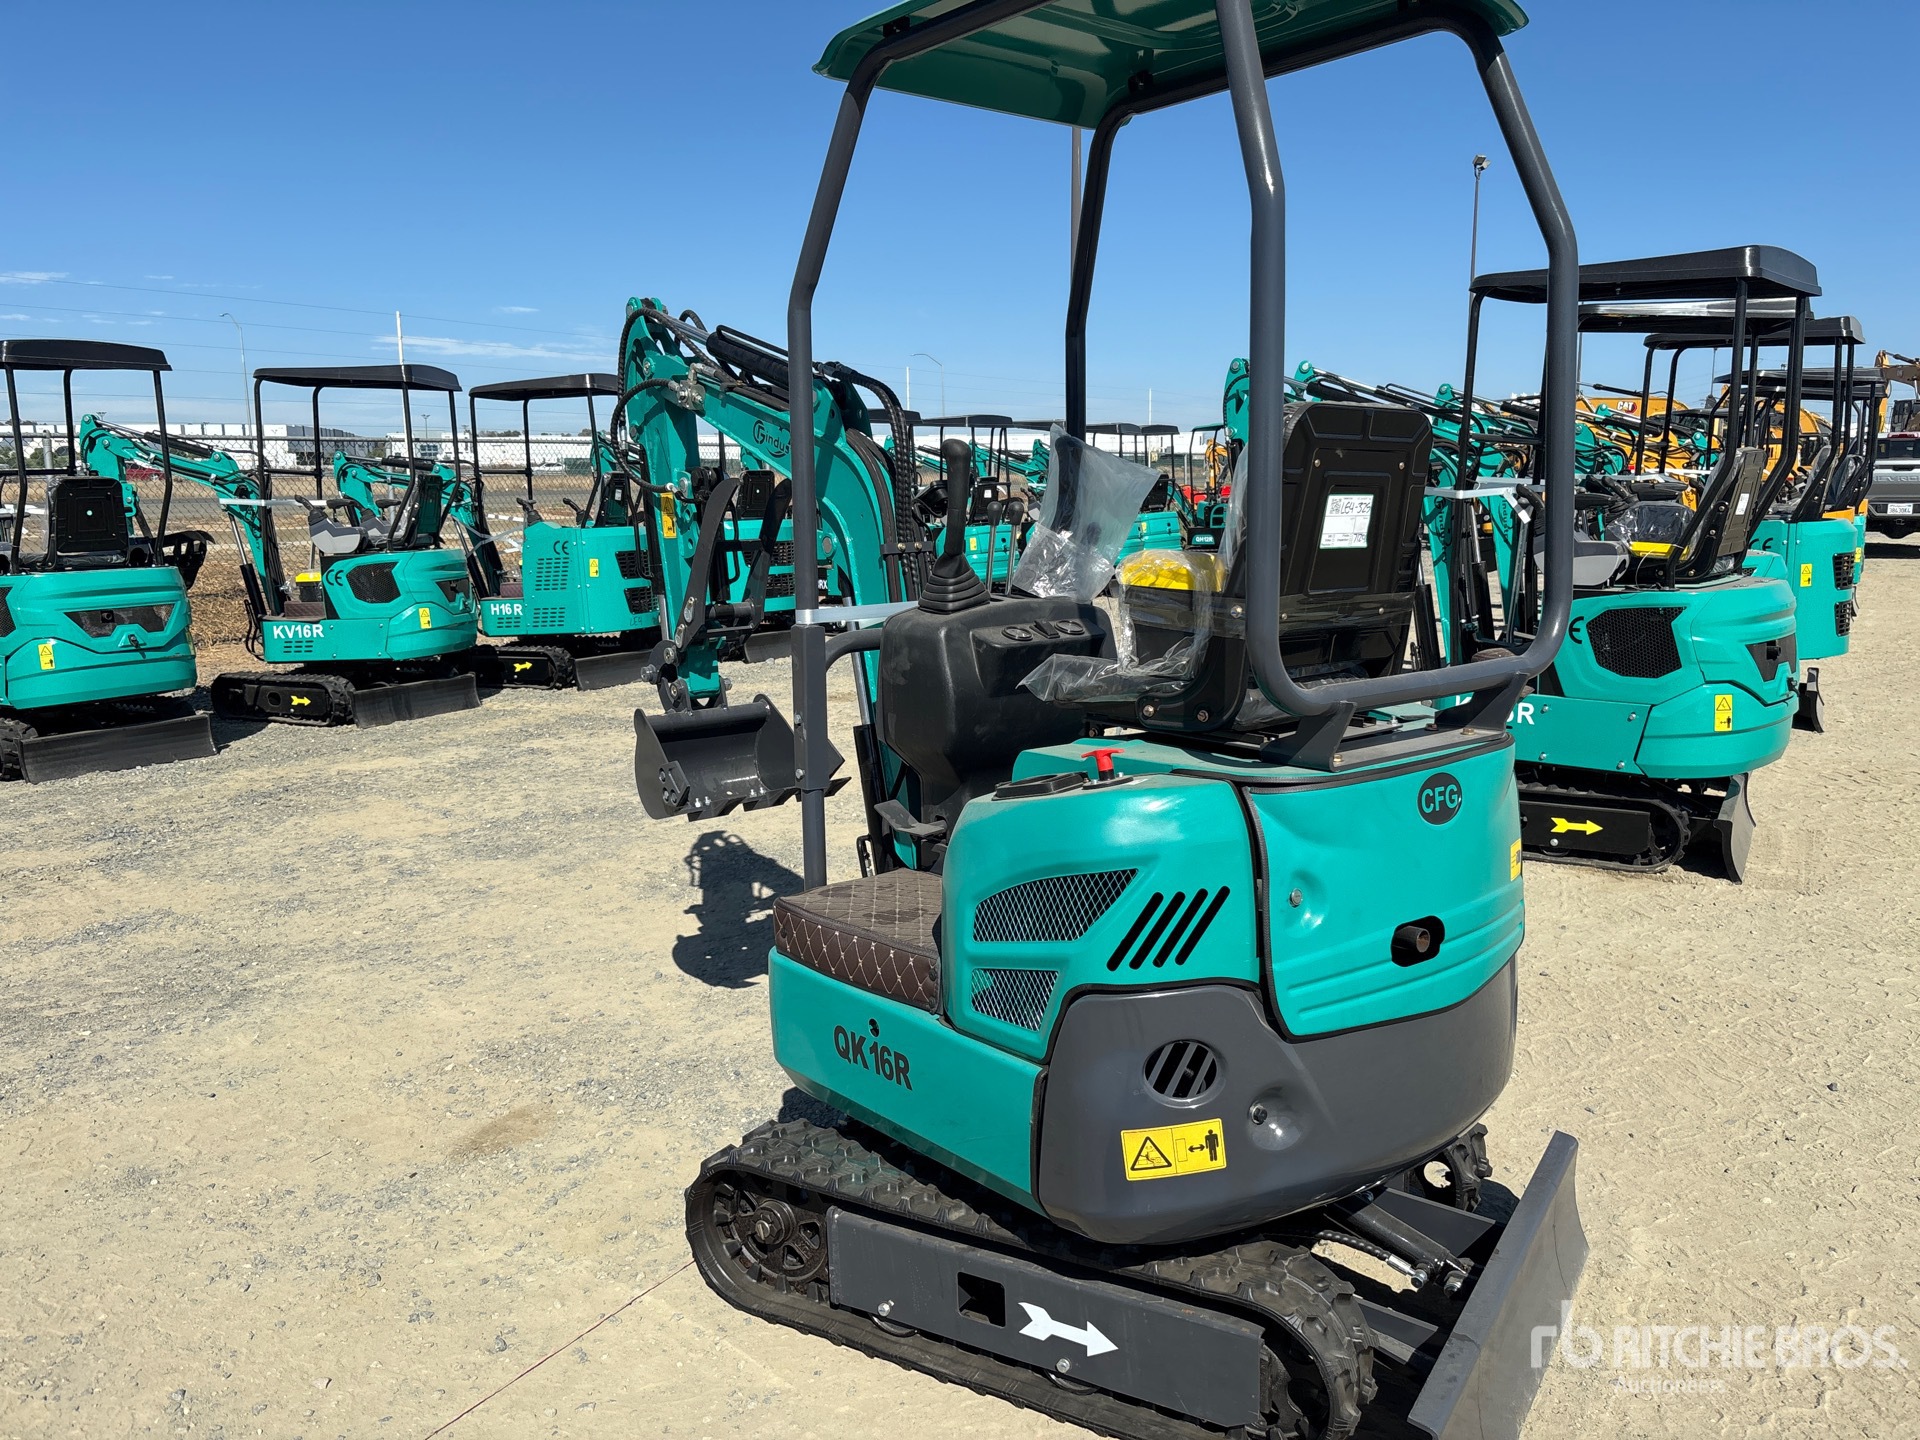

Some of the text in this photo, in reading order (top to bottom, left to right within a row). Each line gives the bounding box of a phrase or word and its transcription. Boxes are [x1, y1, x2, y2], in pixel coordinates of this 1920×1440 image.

[1617, 401, 1634, 412] CAT
[325, 569, 344, 587] CE
[273, 624, 325, 639] KV16R
[1421, 784, 1459, 814] CFG
[833, 1025, 913, 1091] QK16R
